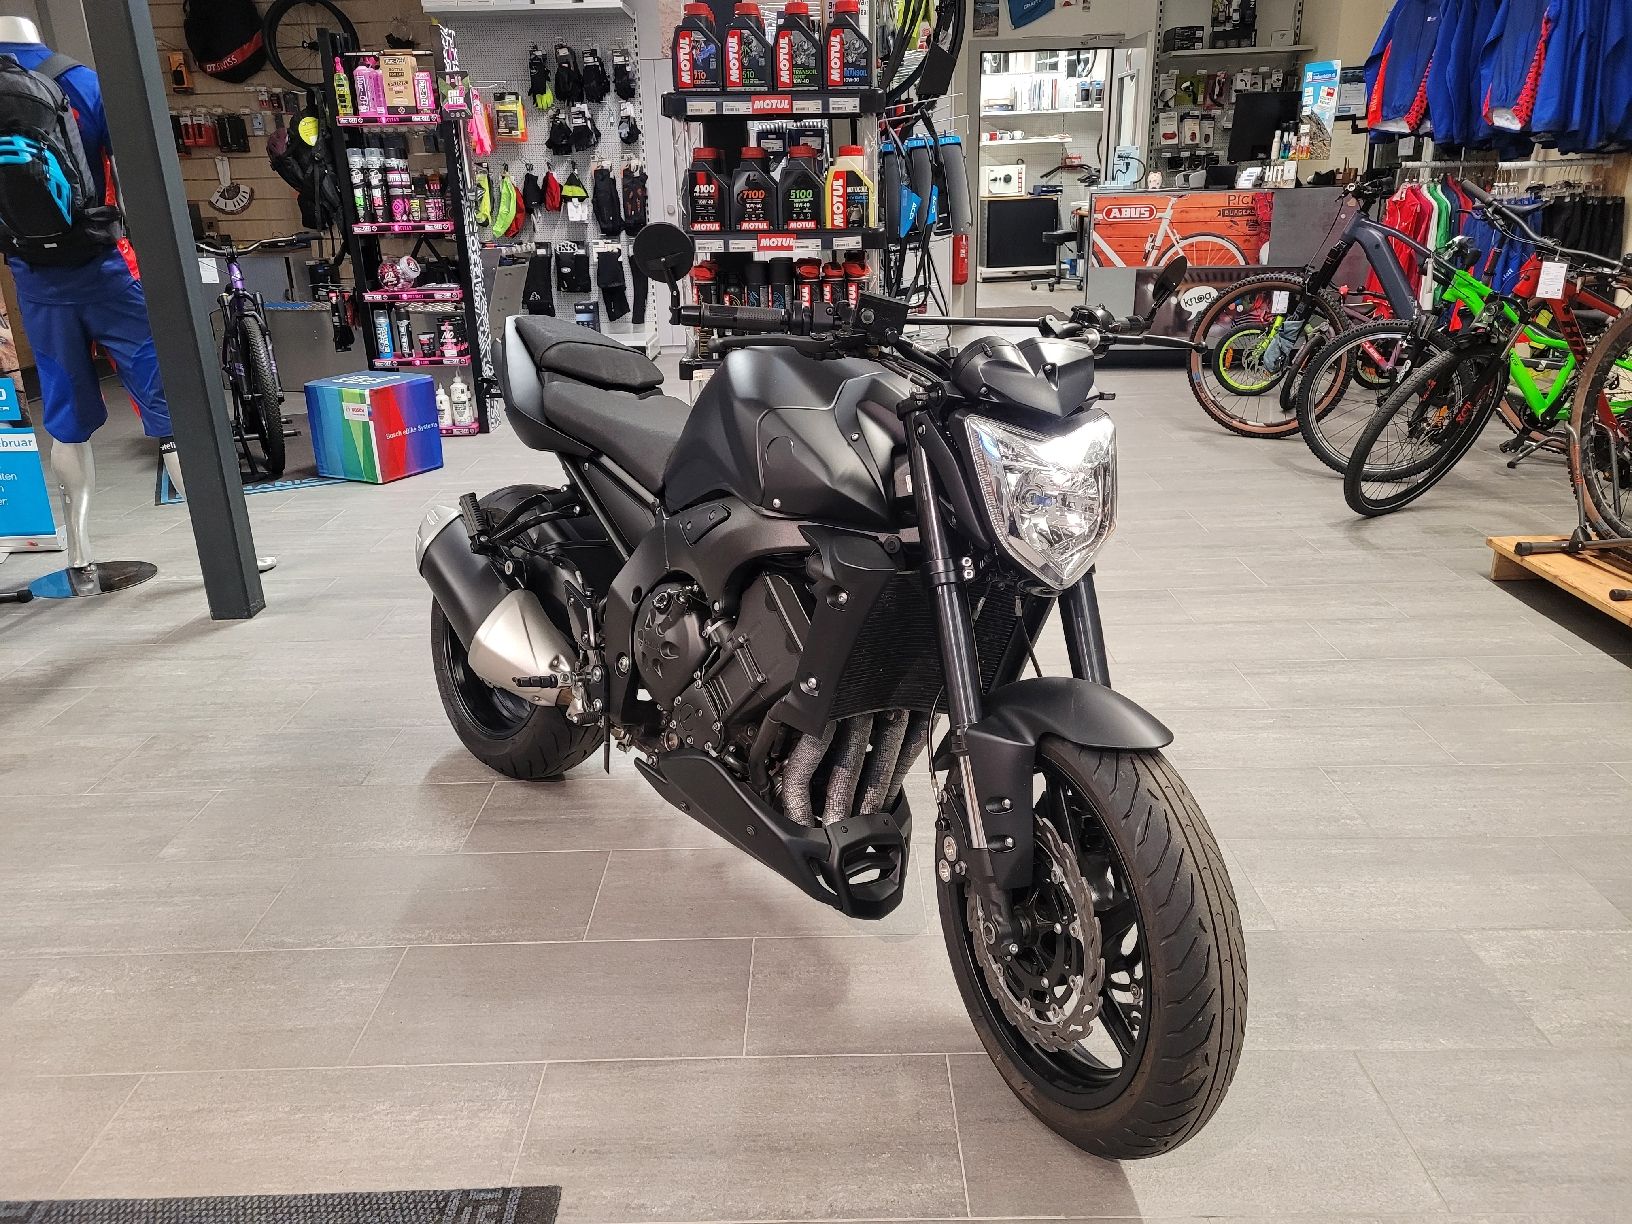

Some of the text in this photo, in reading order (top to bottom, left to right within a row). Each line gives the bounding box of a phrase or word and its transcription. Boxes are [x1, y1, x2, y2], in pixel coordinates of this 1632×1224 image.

[680, 37, 691, 83] MOTUL
[728, 36, 739, 82] MOTUL
[780, 36, 790, 83] MOTUL
[830, 35, 841, 81] MOTUL
[742, 70, 755, 78] 510
[754, 99, 790, 109] MOTUL
[694, 184, 716, 193] 4100
[790, 189, 813, 199] 5100
[832, 178, 844, 227] MOTUL
[1108, 207, 1151, 219] ABUS
[693, 223, 720, 231] MOTUL
[741, 222, 768, 230] MOTUL
[789, 221, 816, 229] MOTUL
[759, 237, 793, 247] MOTUL
[385, 422, 438, 440] Bosch eBike Systems
[0, 438, 33, 448] bruar
